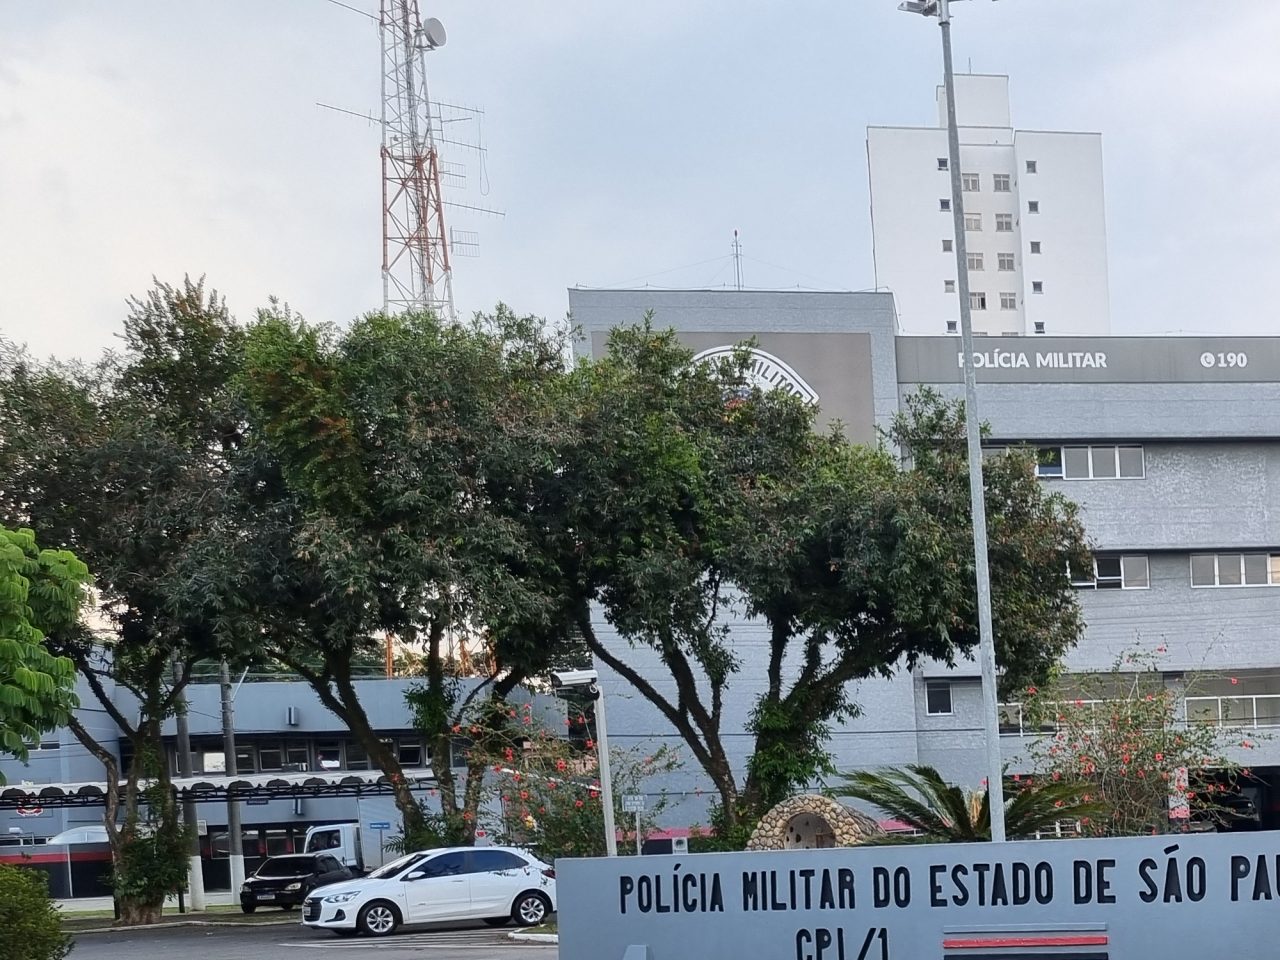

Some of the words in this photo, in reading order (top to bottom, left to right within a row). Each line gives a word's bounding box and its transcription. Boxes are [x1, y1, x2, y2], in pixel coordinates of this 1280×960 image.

[958, 348, 1030, 368] POLÍCIA
[1036, 352, 1107, 368] MILITAR
[1217, 352, 1248, 368] 190
[619, 863, 725, 915] POLÍCIA
[742, 868, 856, 912] MILITAR
[872, 866, 912, 908] DO
[929, 861, 1054, 908] ESTADO
[1073, 859, 1117, 905] DE
